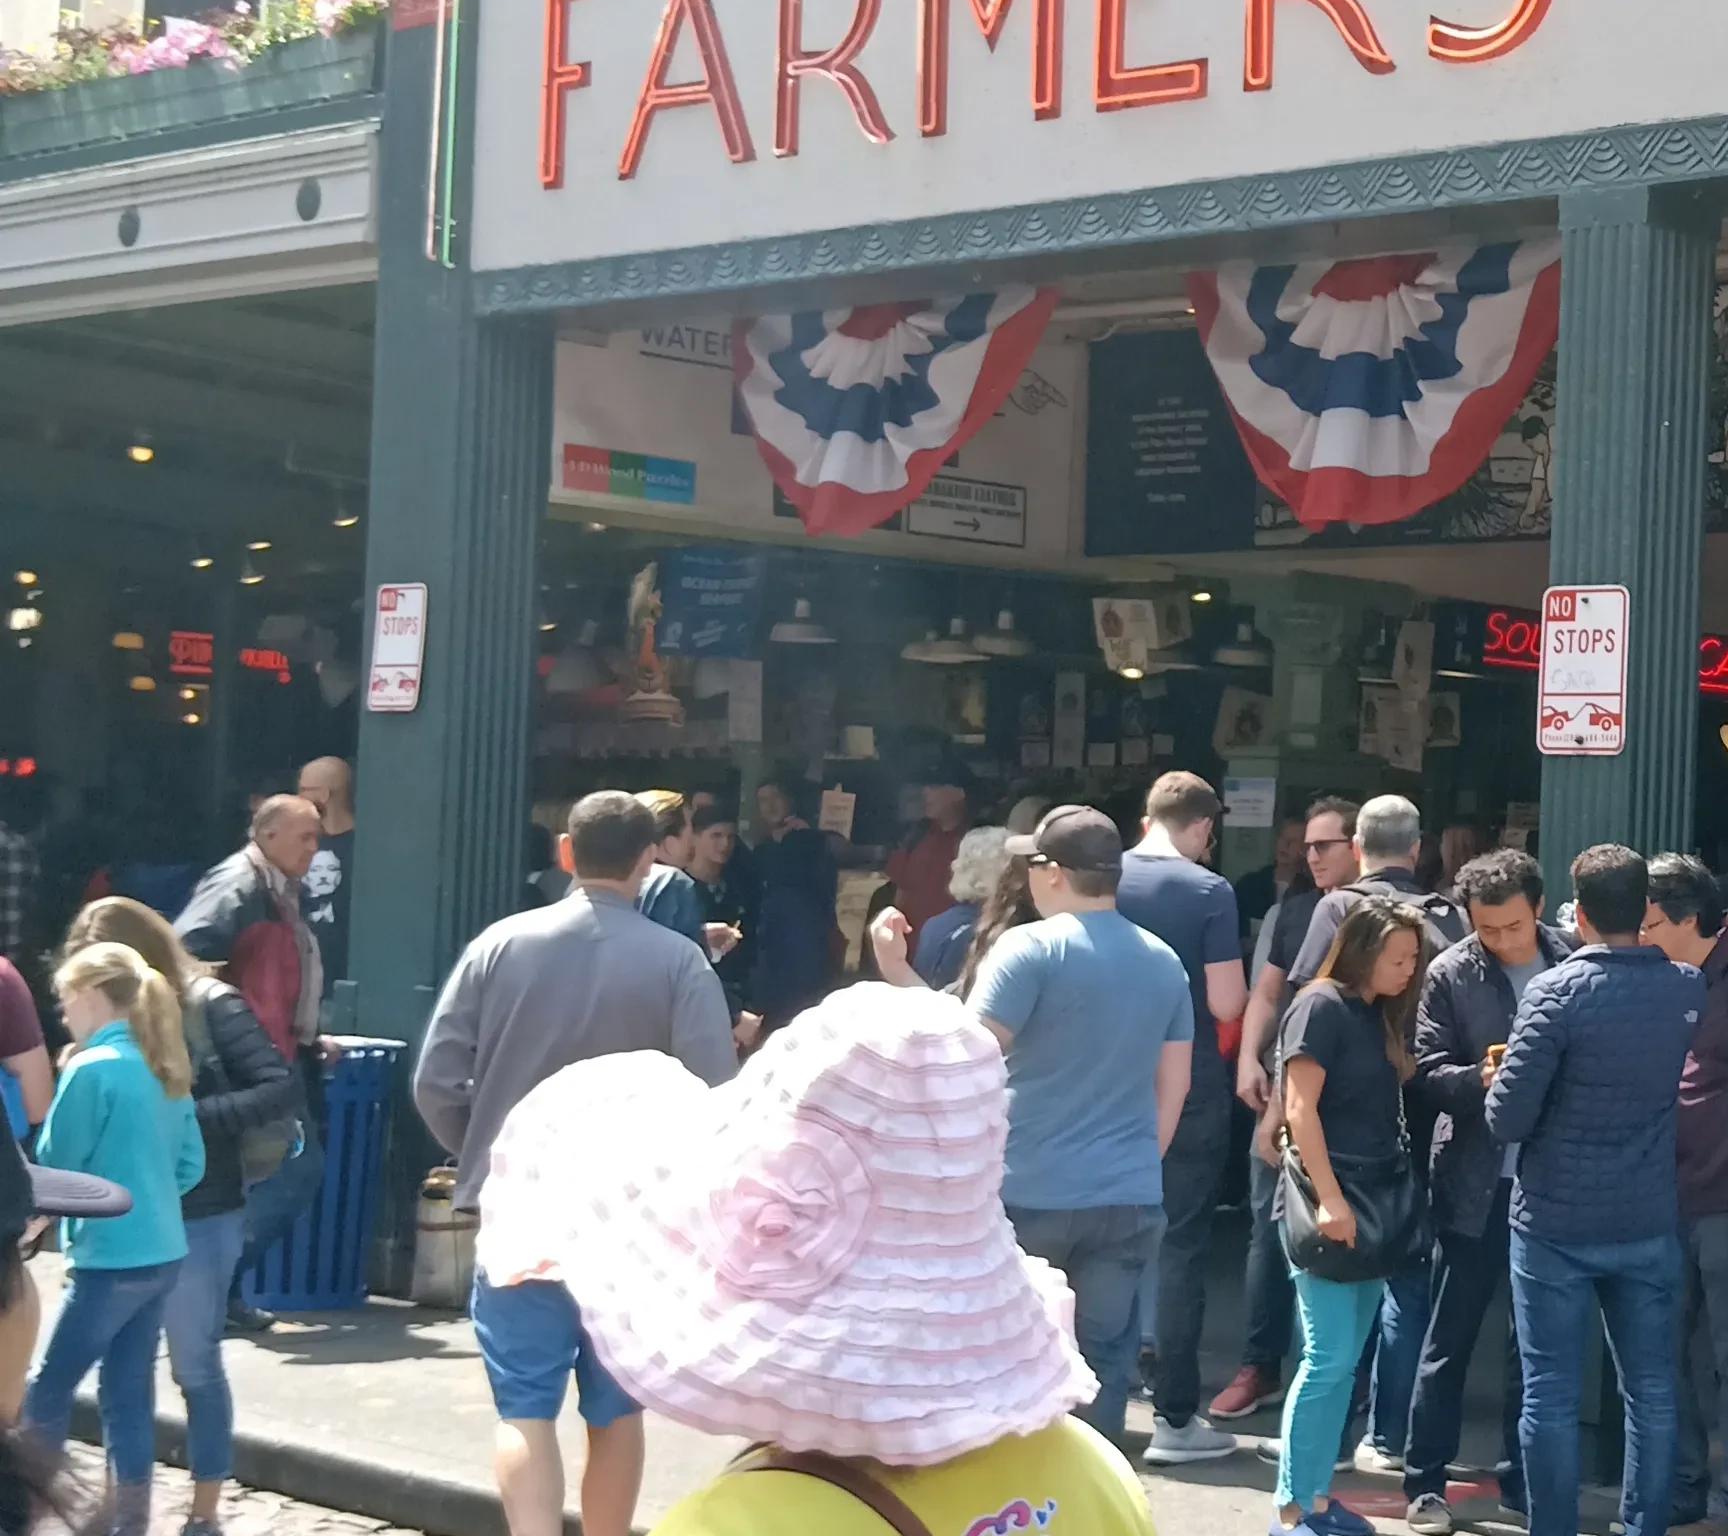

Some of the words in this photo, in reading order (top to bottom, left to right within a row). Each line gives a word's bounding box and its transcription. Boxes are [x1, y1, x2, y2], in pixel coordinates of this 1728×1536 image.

[1549, 596, 1572, 618] NO
[384, 616, 418, 635] STOPS
[1553, 628, 1616, 654] STOPS
